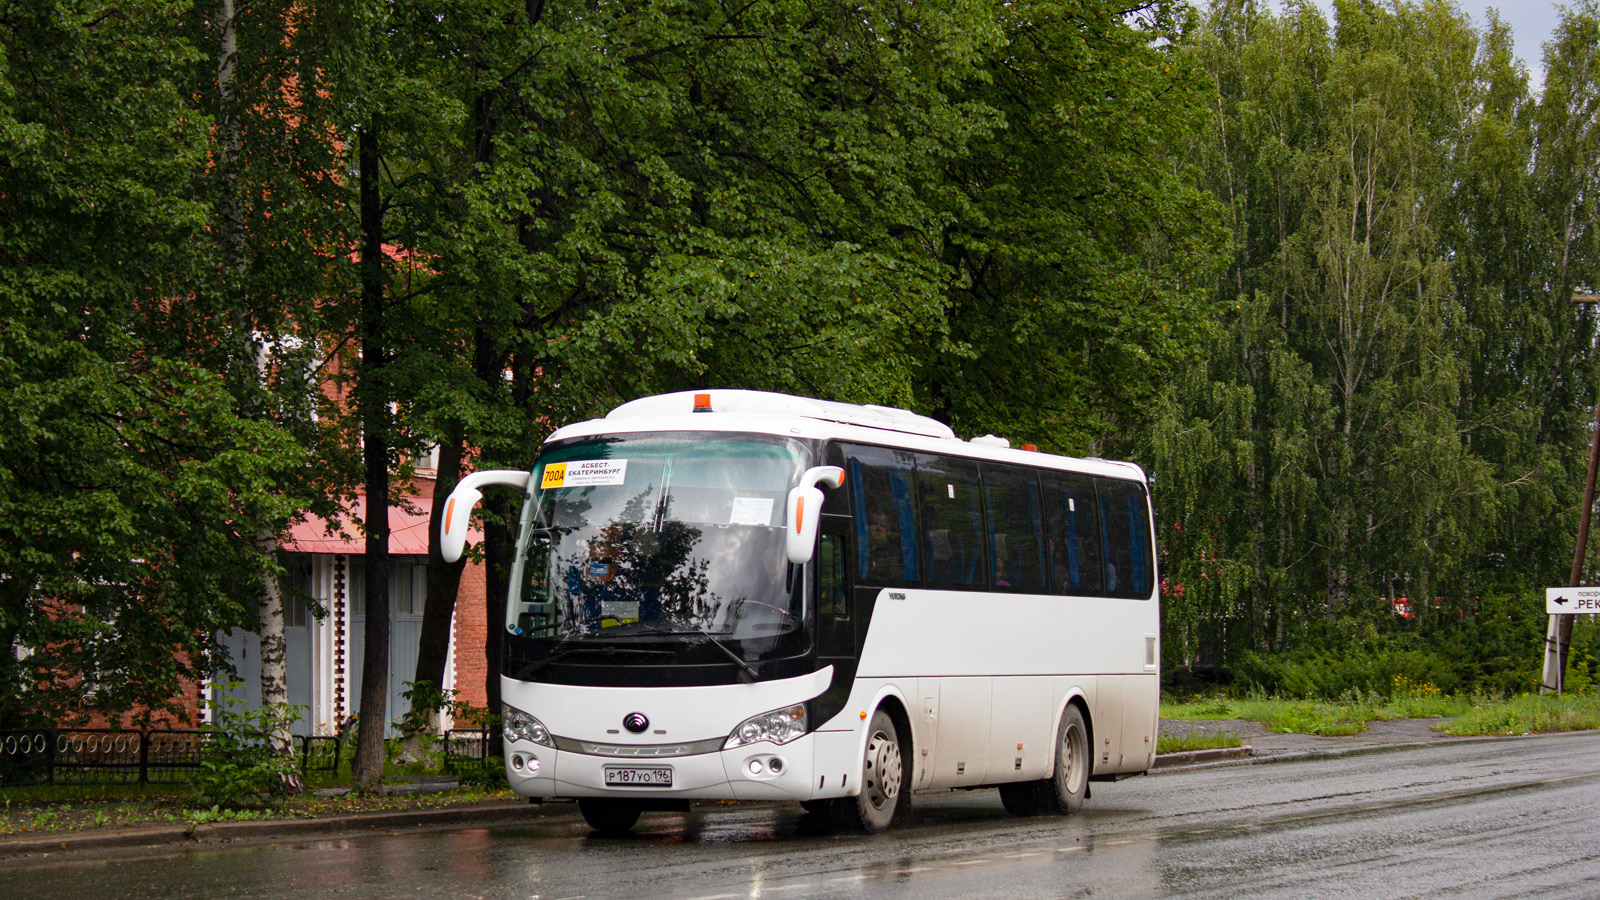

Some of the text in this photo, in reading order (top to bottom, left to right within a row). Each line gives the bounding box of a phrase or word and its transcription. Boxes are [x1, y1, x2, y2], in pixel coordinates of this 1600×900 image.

[544, 470, 564, 482] 700А
[568, 468, 621, 477] ЕКАТЕРИНБУРГ
[652, 770, 669, 780] 196
